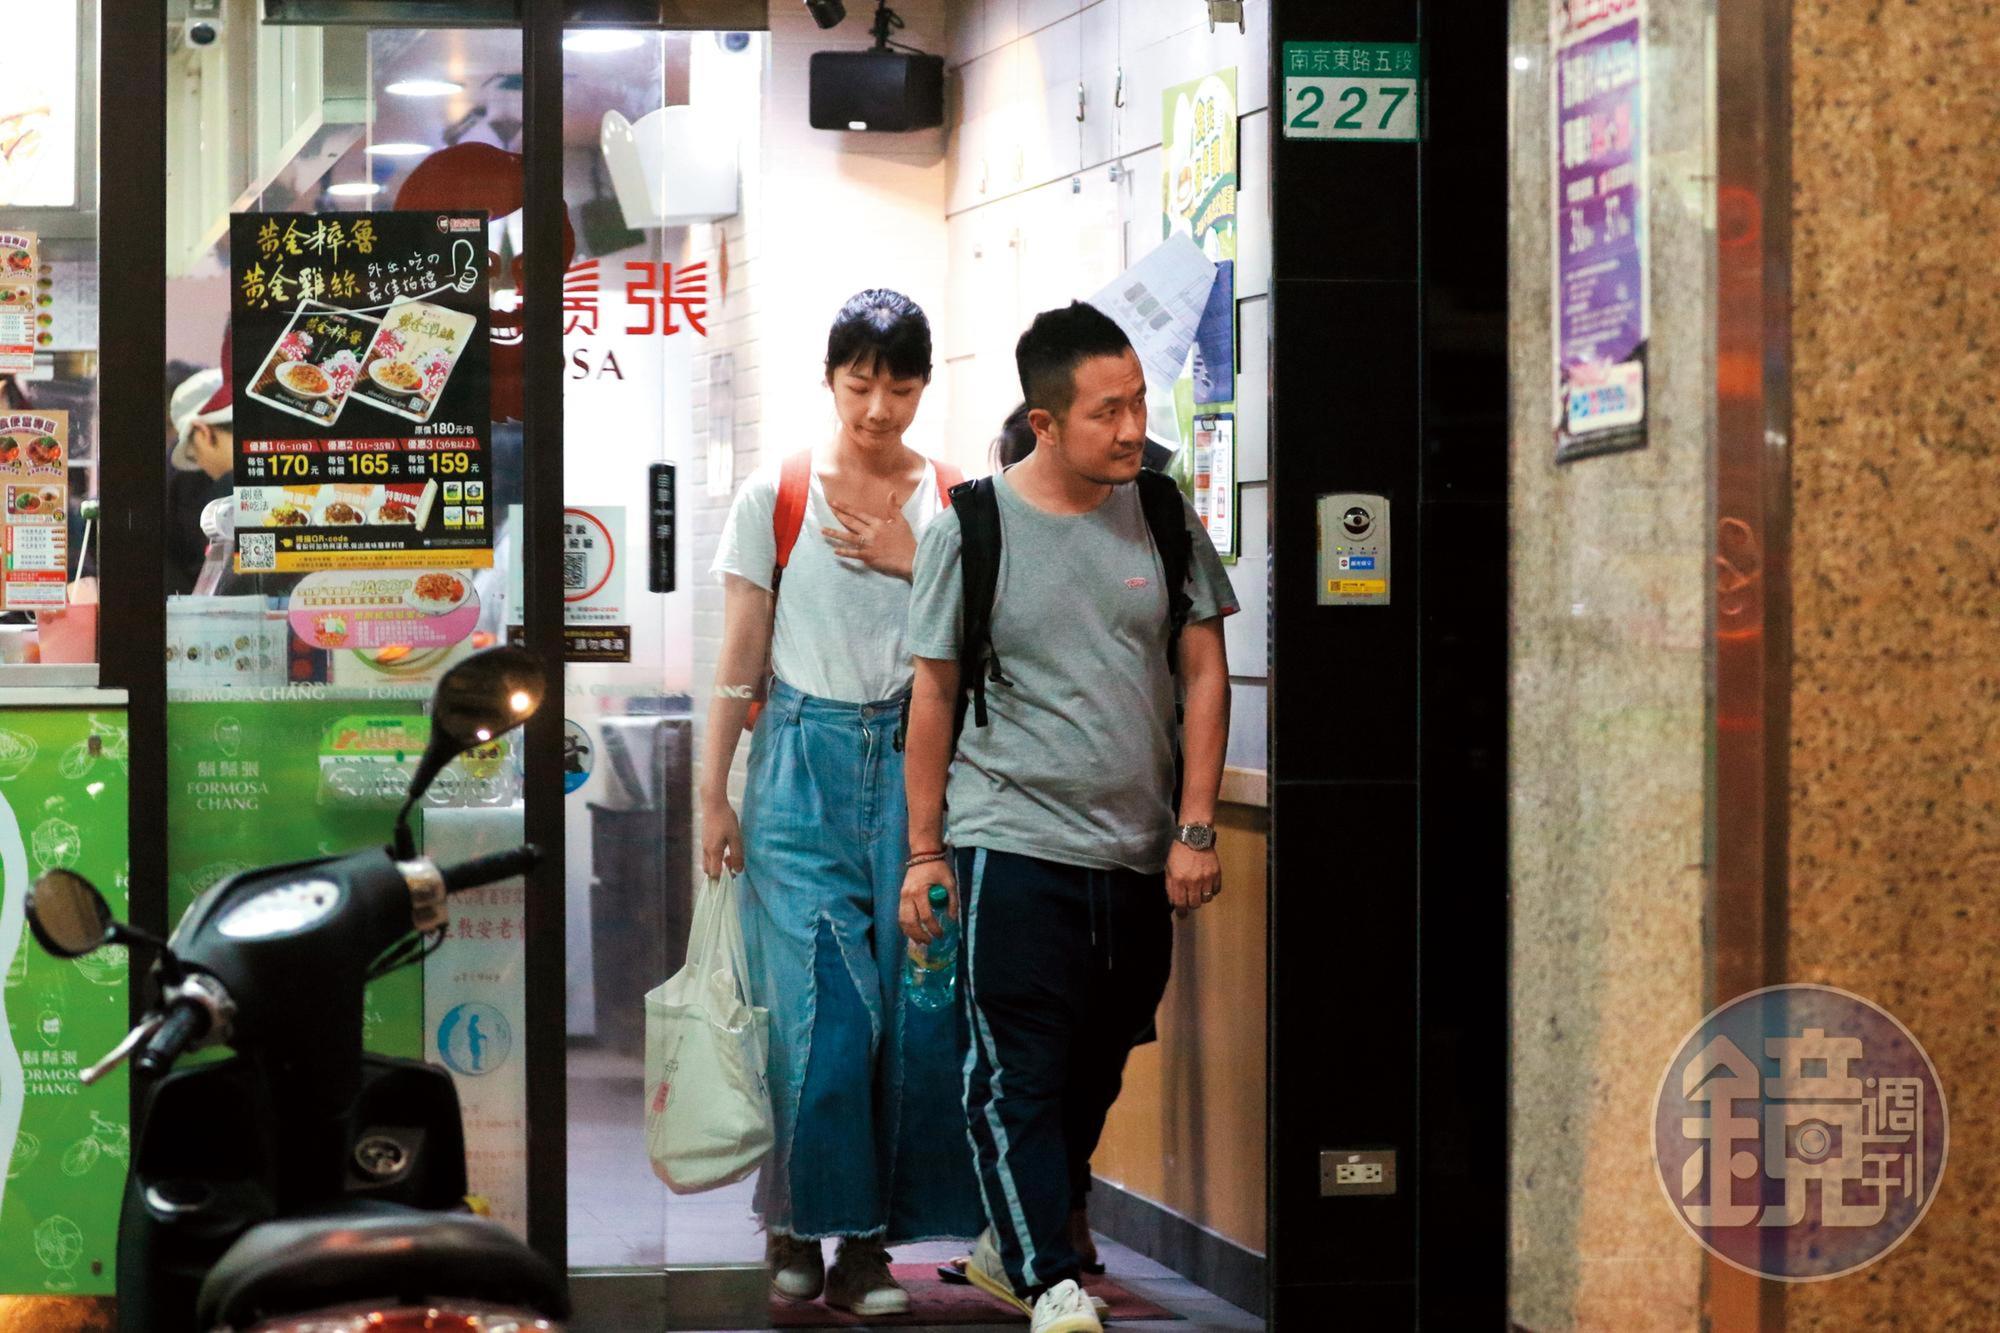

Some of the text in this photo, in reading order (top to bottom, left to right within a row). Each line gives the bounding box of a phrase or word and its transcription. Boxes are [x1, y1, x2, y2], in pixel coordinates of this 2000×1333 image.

[1289, 49, 1413, 71] 南京東路五段
[1290, 86, 1410, 130] 227
[563, 348, 624, 380] SA
[267, 454, 309, 476] 170
[348, 453, 389, 475] 165
[428, 452, 469, 474] 159
[187, 781, 269, 794] FORMOSA
[196, 797, 259, 810] CHANG
[22, 1068, 80, 1081] ORMOS
[23, 1083, 79, 1095] CHANG
